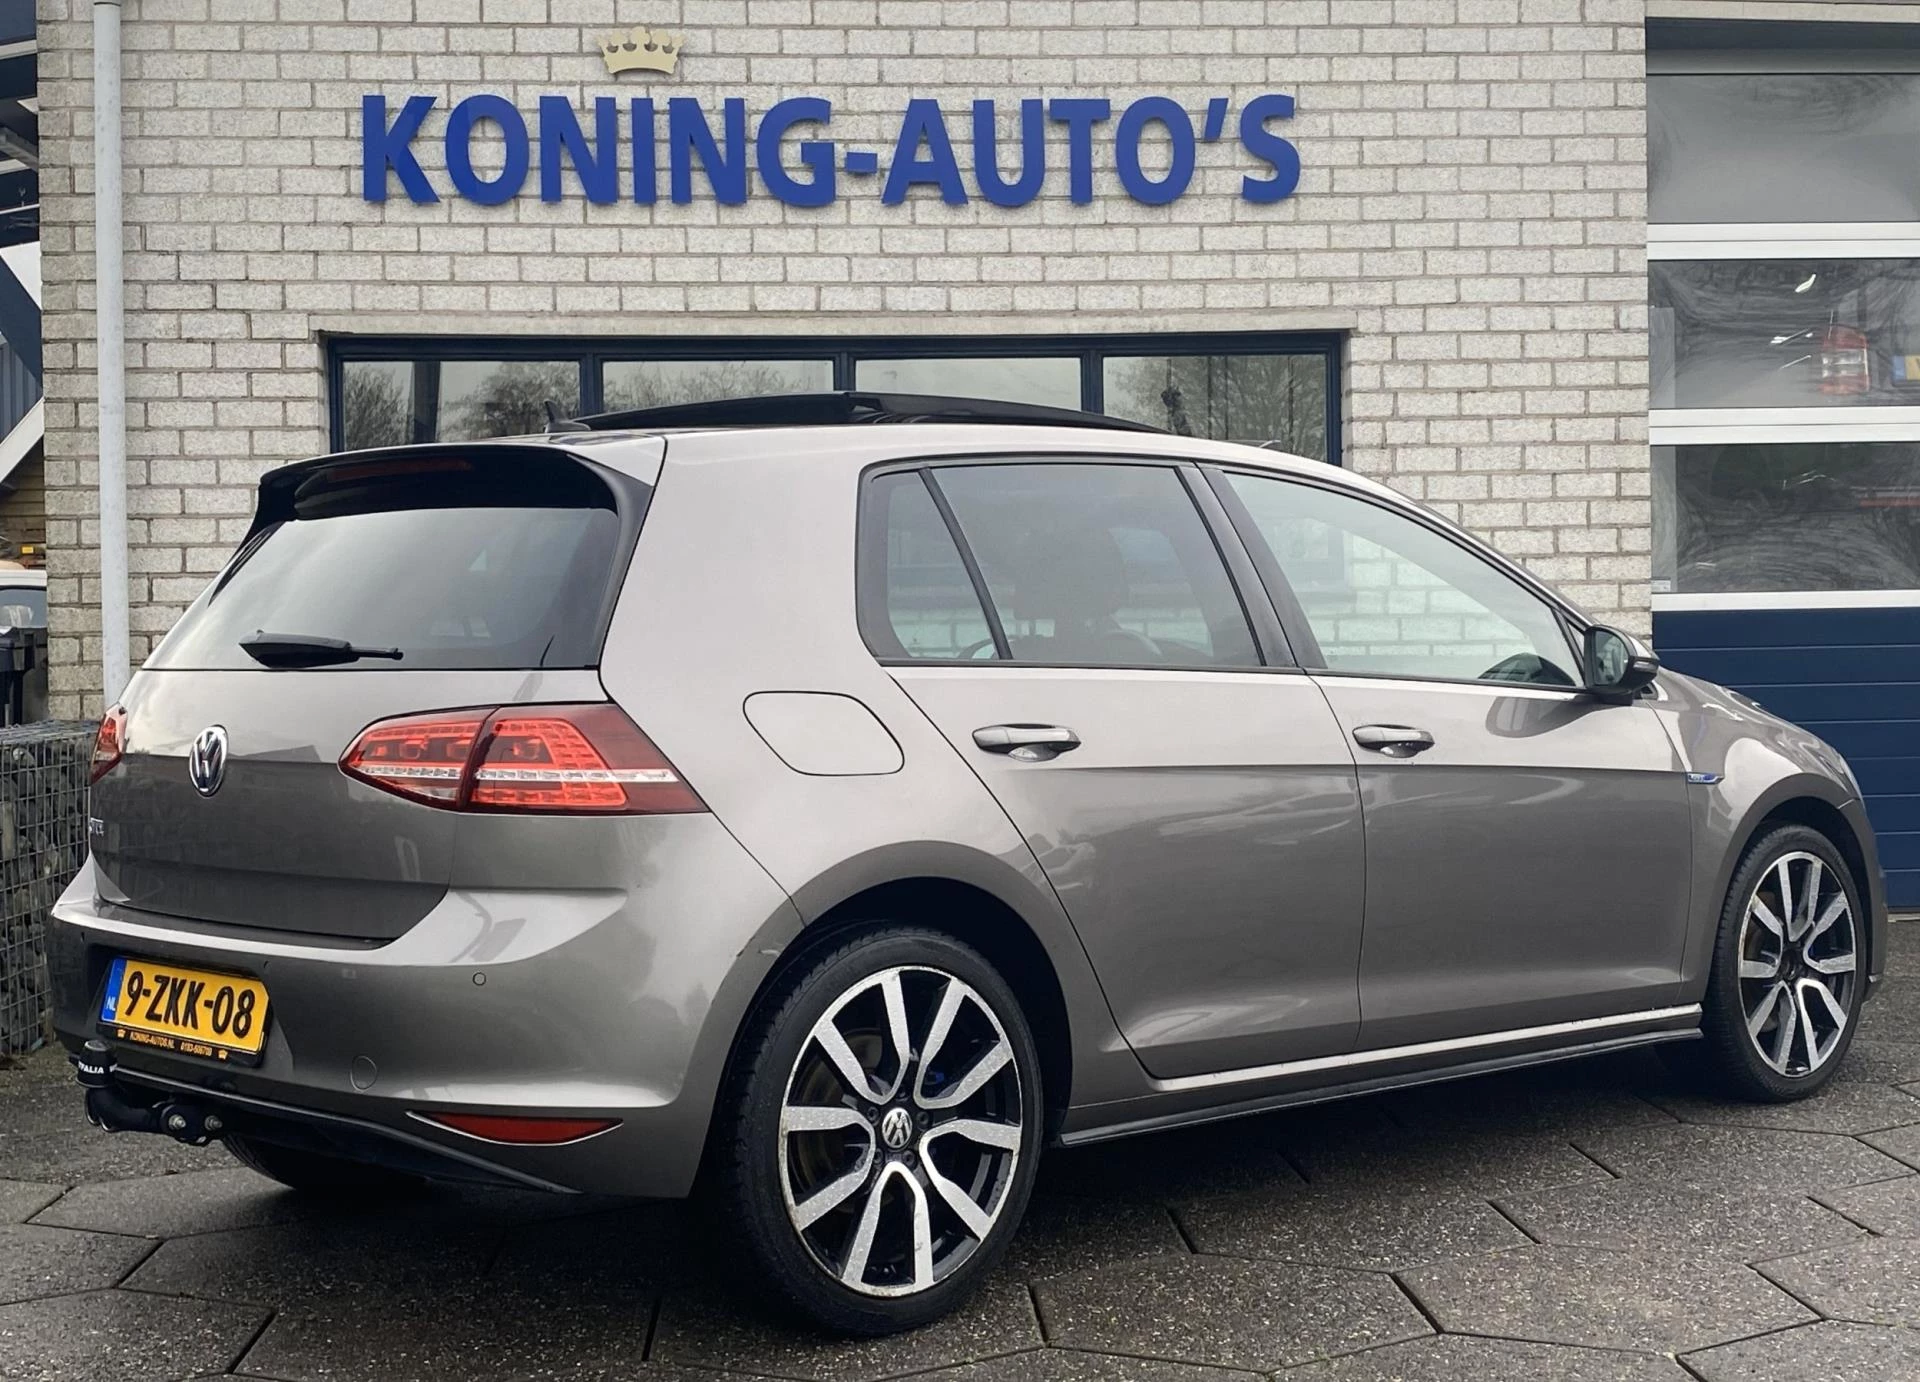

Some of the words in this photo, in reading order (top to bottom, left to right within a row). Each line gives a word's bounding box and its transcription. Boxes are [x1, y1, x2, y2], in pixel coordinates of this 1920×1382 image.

[363, 95, 1299, 205] KONING-AUTO'S
[105, 996, 116, 1011] NL
[125, 970, 256, 1039] 9-ZKK-08
